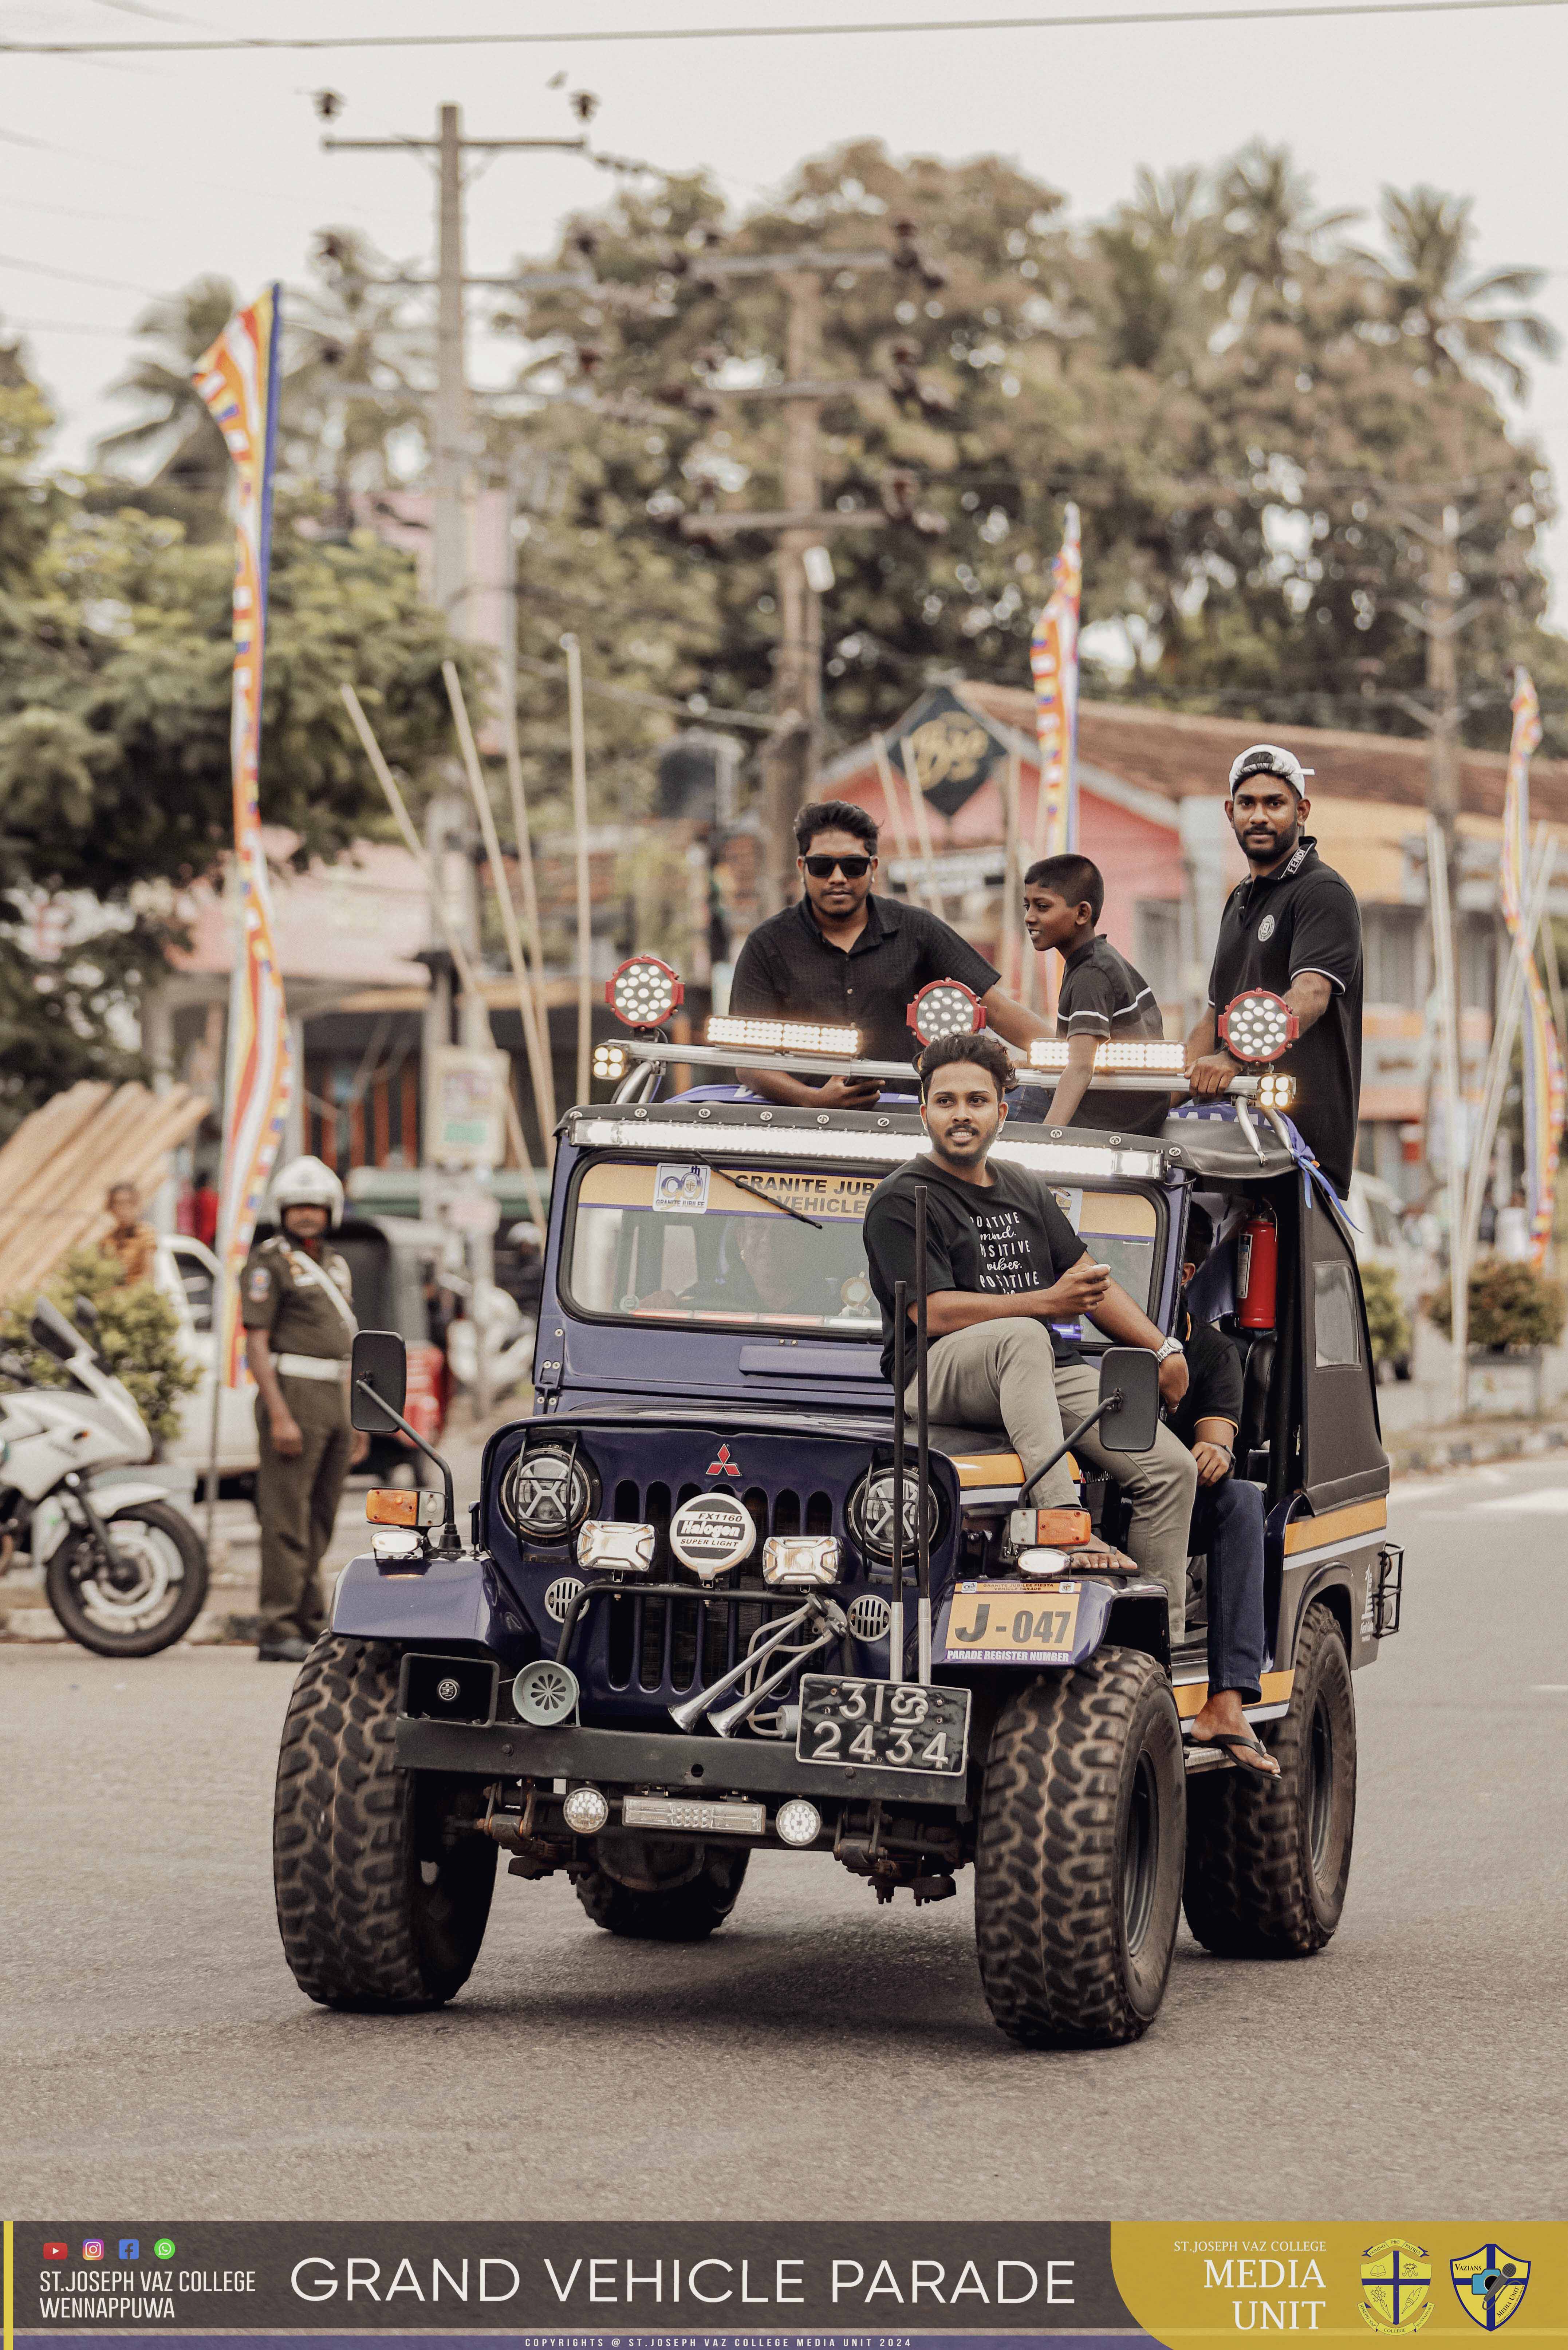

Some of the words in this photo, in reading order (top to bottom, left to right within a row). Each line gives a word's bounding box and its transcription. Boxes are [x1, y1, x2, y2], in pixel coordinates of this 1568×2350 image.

[1287, 849, 1306, 873] FENDI
[777, 1195, 866, 1214] VEHICLE
[986, 1257, 1023, 1270] vibes.
[698, 1513, 742, 1522] FX1160
[947, 1650, 983, 1660] PARADE
[984, 1651, 1028, 1661] REGISTER
[1029, 1651, 1069, 1662] NUMBER
[812, 1720, 948, 1770] 2434
